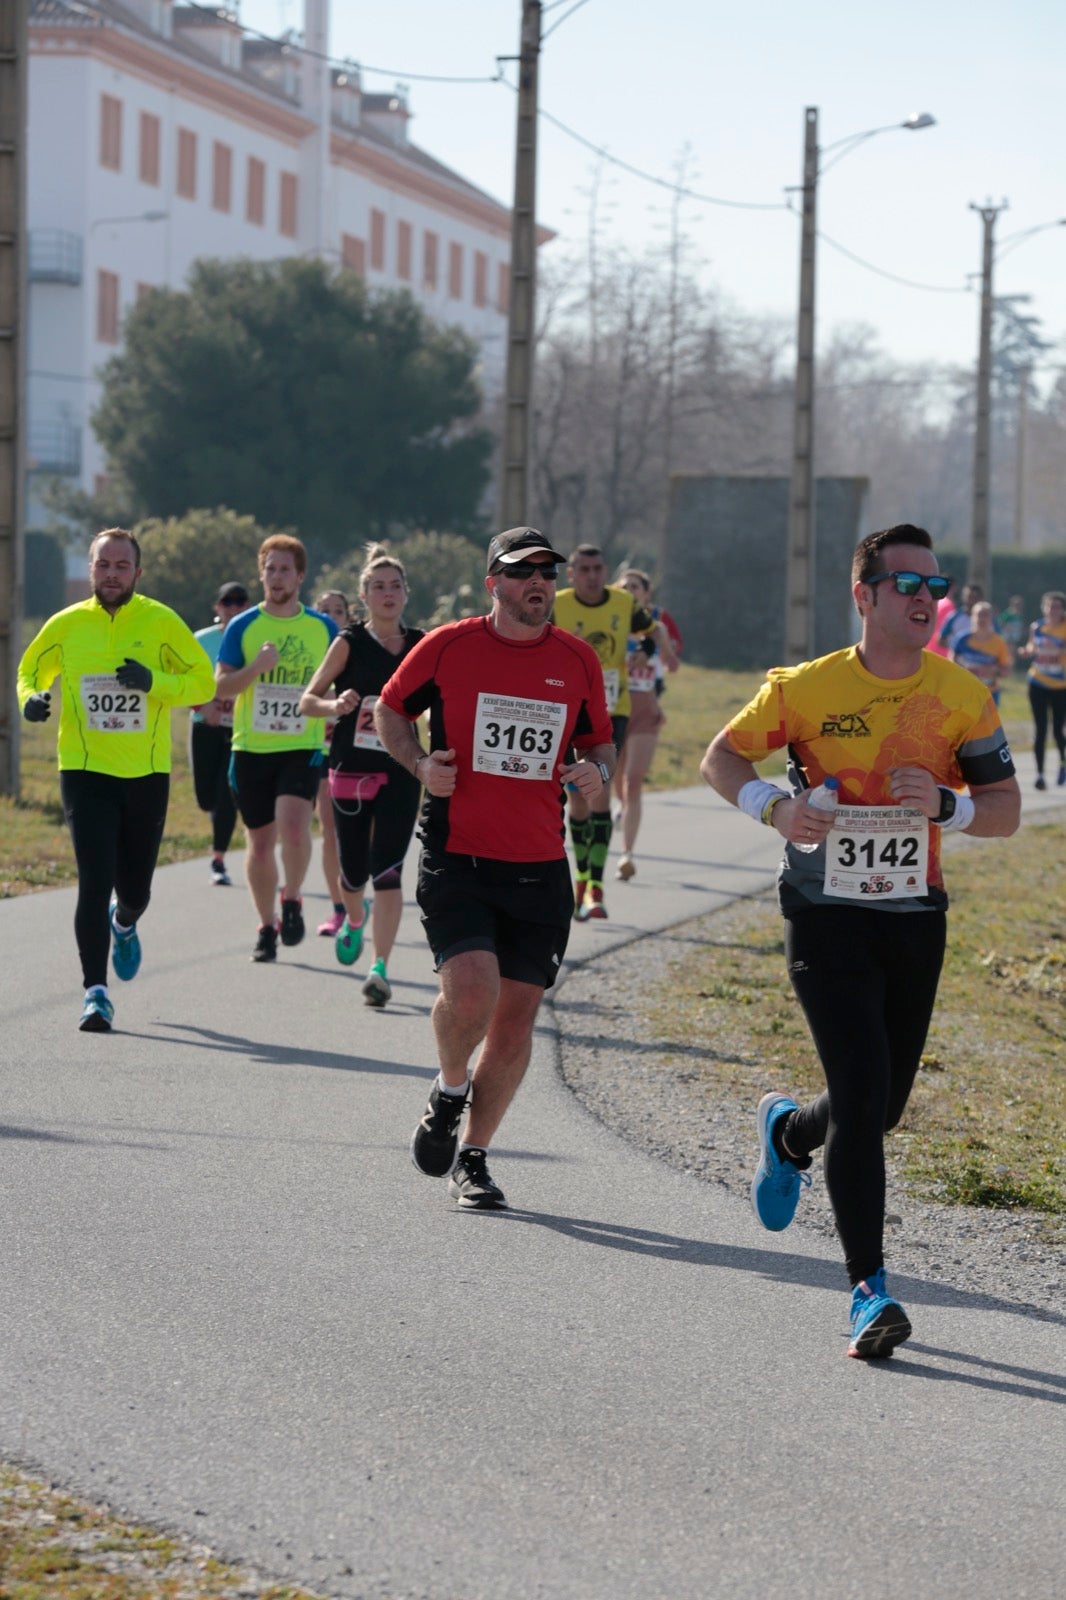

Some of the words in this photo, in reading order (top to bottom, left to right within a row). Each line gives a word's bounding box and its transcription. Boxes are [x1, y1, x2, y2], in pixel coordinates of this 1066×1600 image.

[88, 694, 140, 712] 3022
[536, 704, 543, 712] DE
[484, 722, 553, 754] 3163
[851, 810, 869, 819] GRAN
[870, 810, 894, 819] PREMIO
[894, 809, 903, 818] DE
[838, 837, 919, 868] 3142
